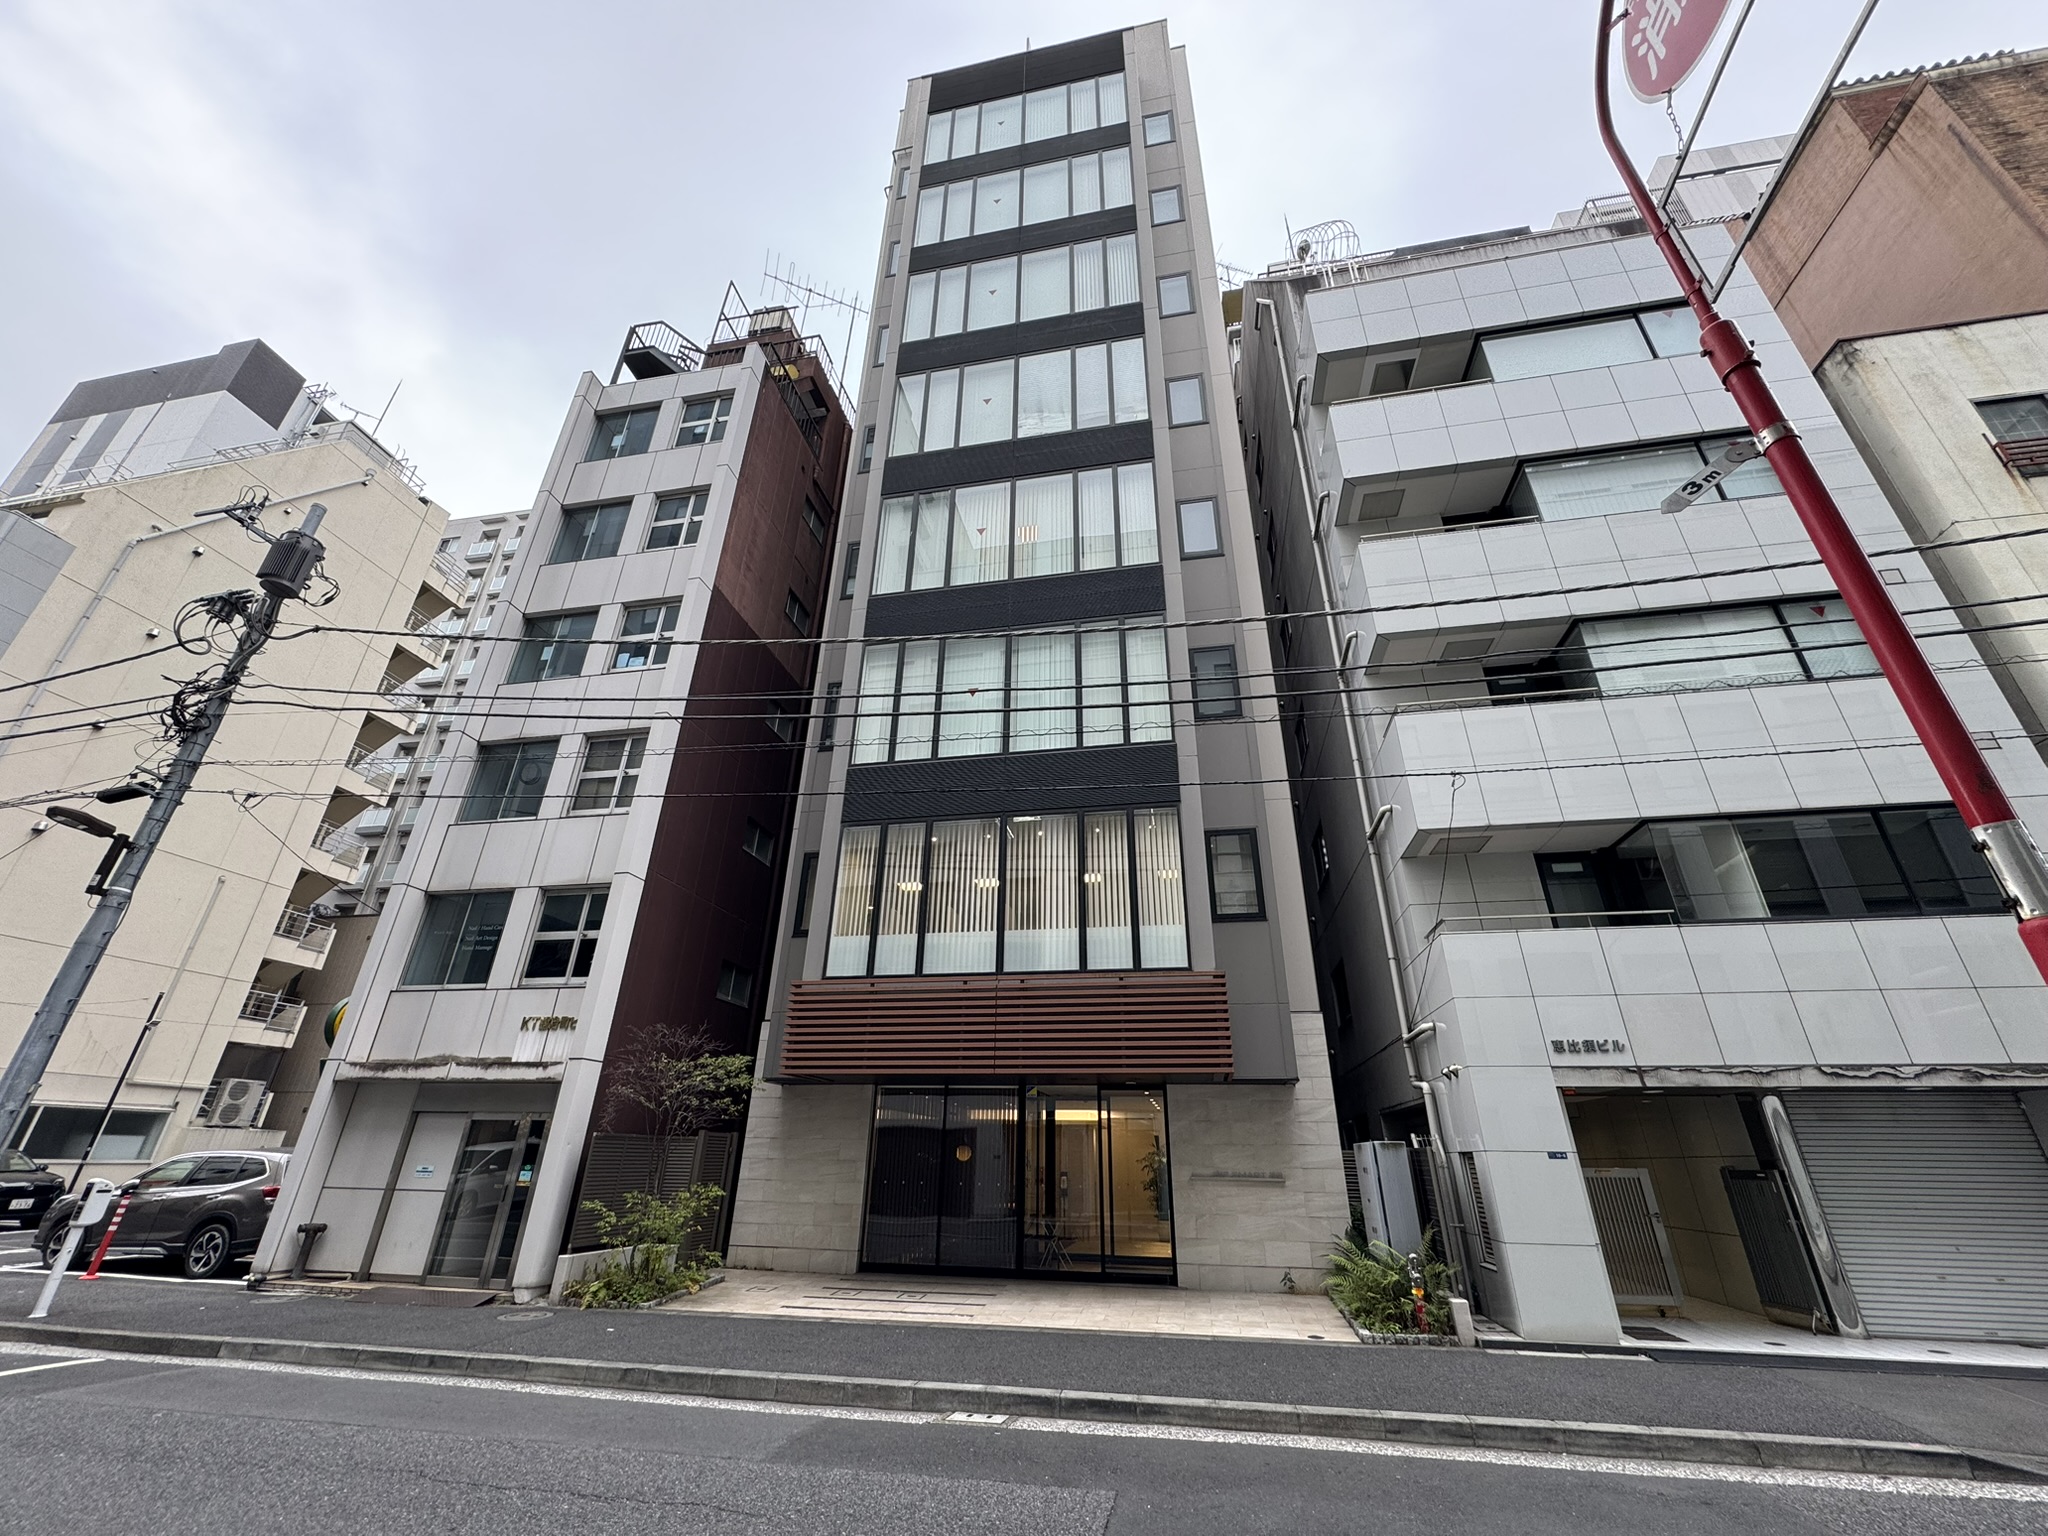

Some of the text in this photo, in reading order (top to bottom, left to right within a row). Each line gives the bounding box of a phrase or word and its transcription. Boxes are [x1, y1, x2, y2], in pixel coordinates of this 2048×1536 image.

[1631, 0, 1686, 80] 消
[1551, 1039, 1625, 1053] 恵比須ビル
